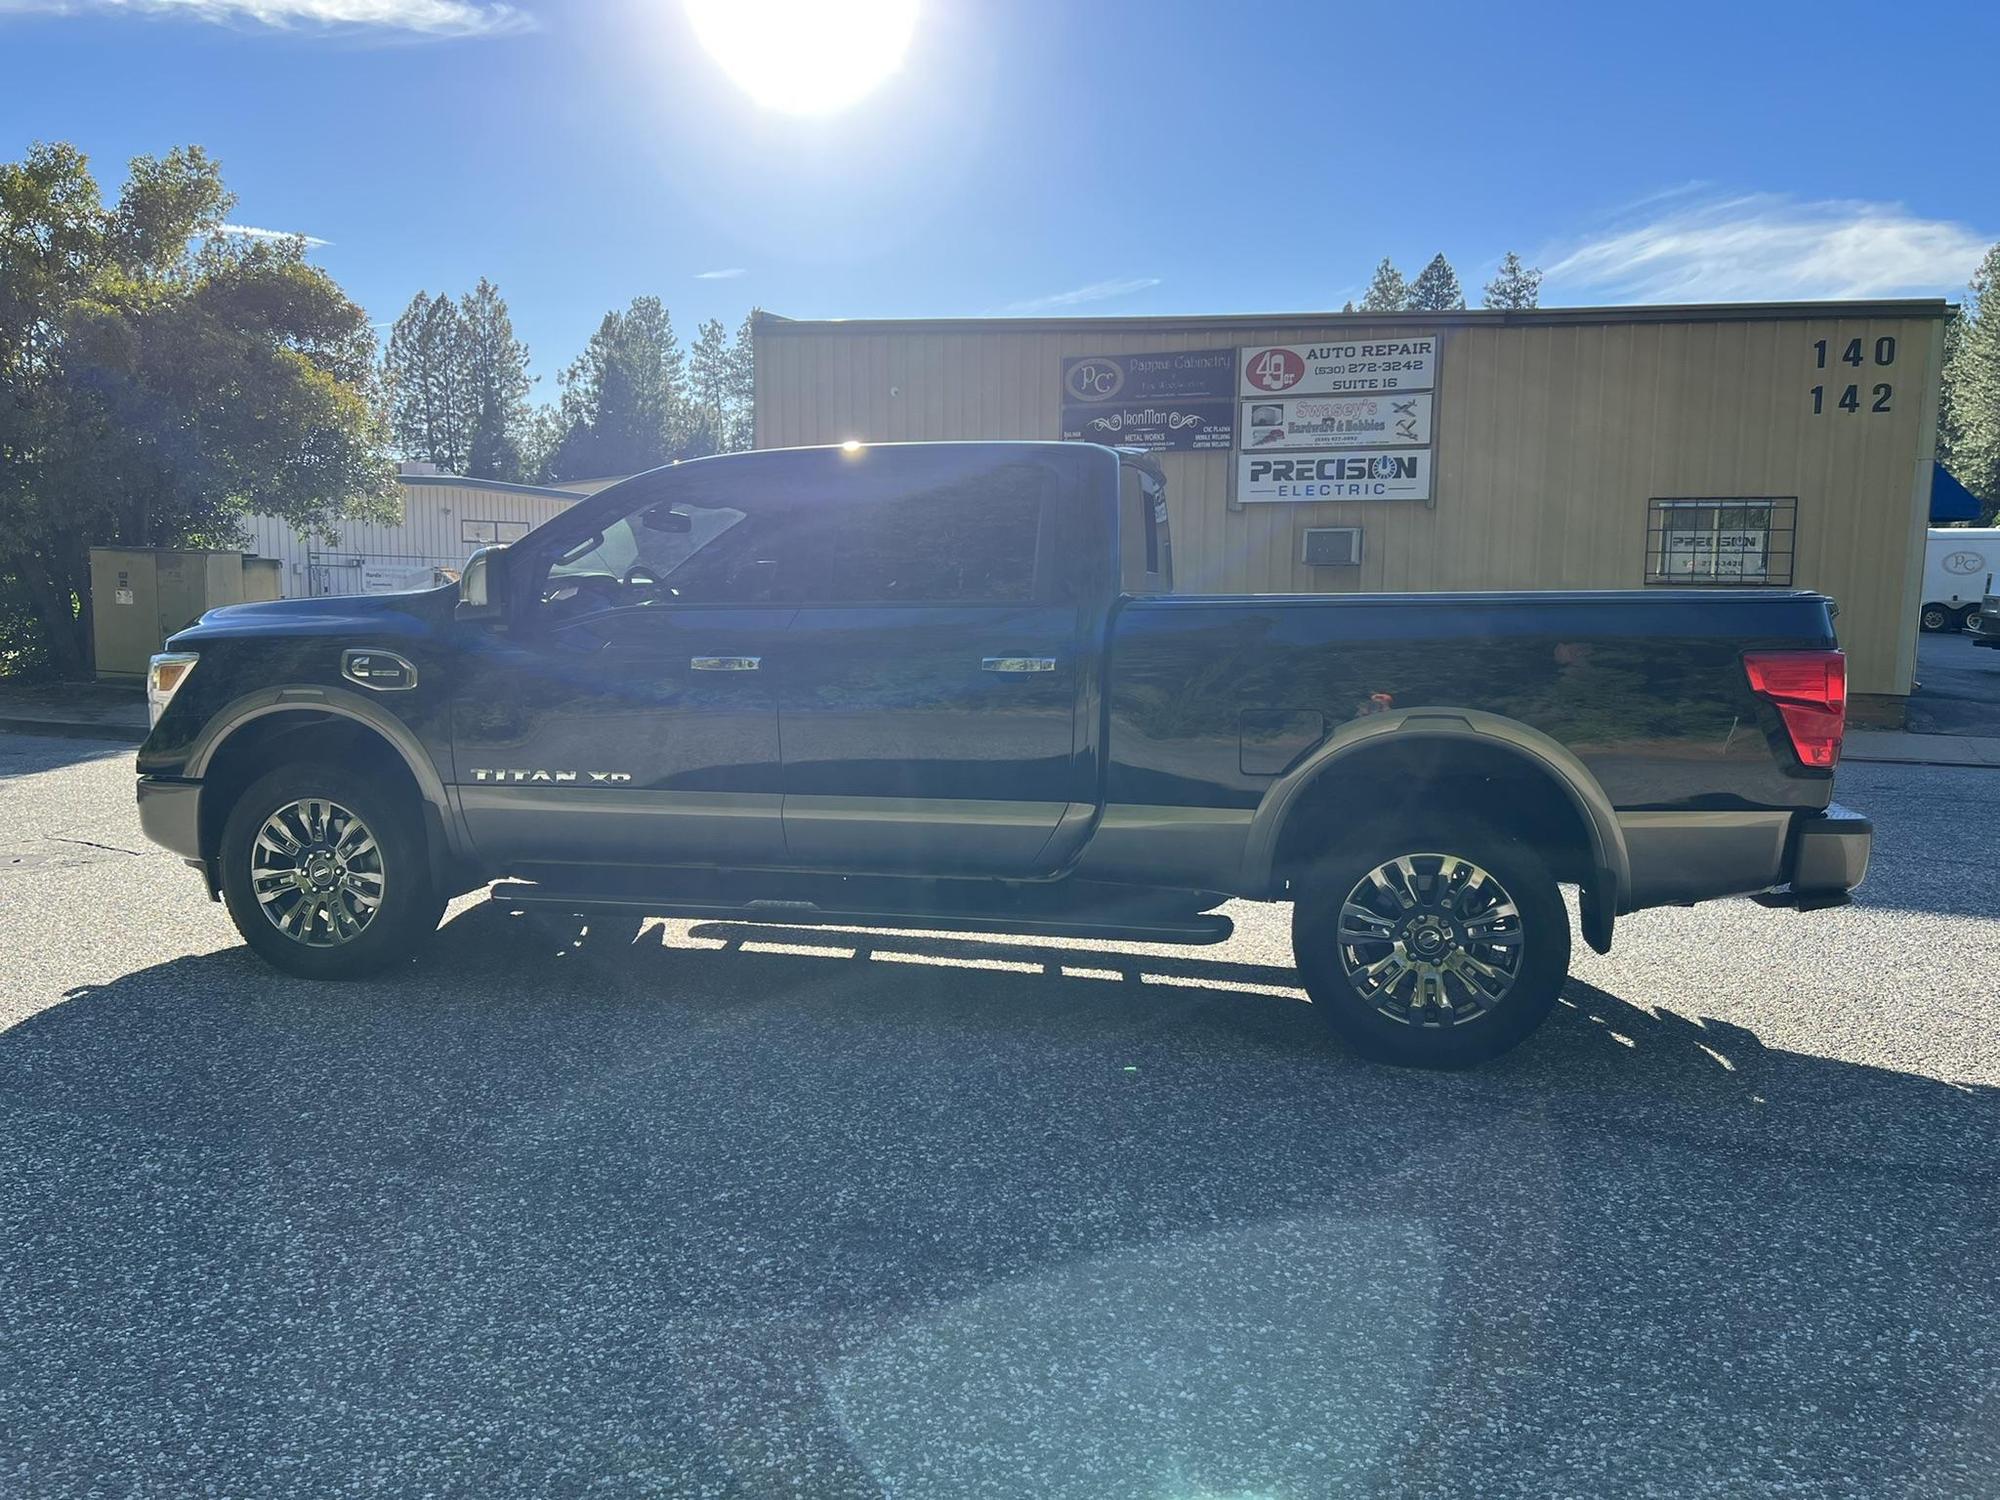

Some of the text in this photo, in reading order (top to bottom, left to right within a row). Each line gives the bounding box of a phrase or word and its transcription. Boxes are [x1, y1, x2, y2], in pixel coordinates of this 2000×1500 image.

[1306, 342, 1432, 360] AUTO REPAIR
[1813, 336, 1896, 369] 140
[1314, 360, 1423, 375] (530) 272-3242
[1333, 378, 1398, 390] SUITE 16
[1810, 383, 1893, 414] 142
[1296, 399, 1377, 420] Swasey's
[1250, 455, 1418, 482] PRECISION
[1278, 484, 1386, 497] ELECTRIC
[1672, 535, 1756, 547] PRECSION
[470, 768, 577, 783] TITAN
